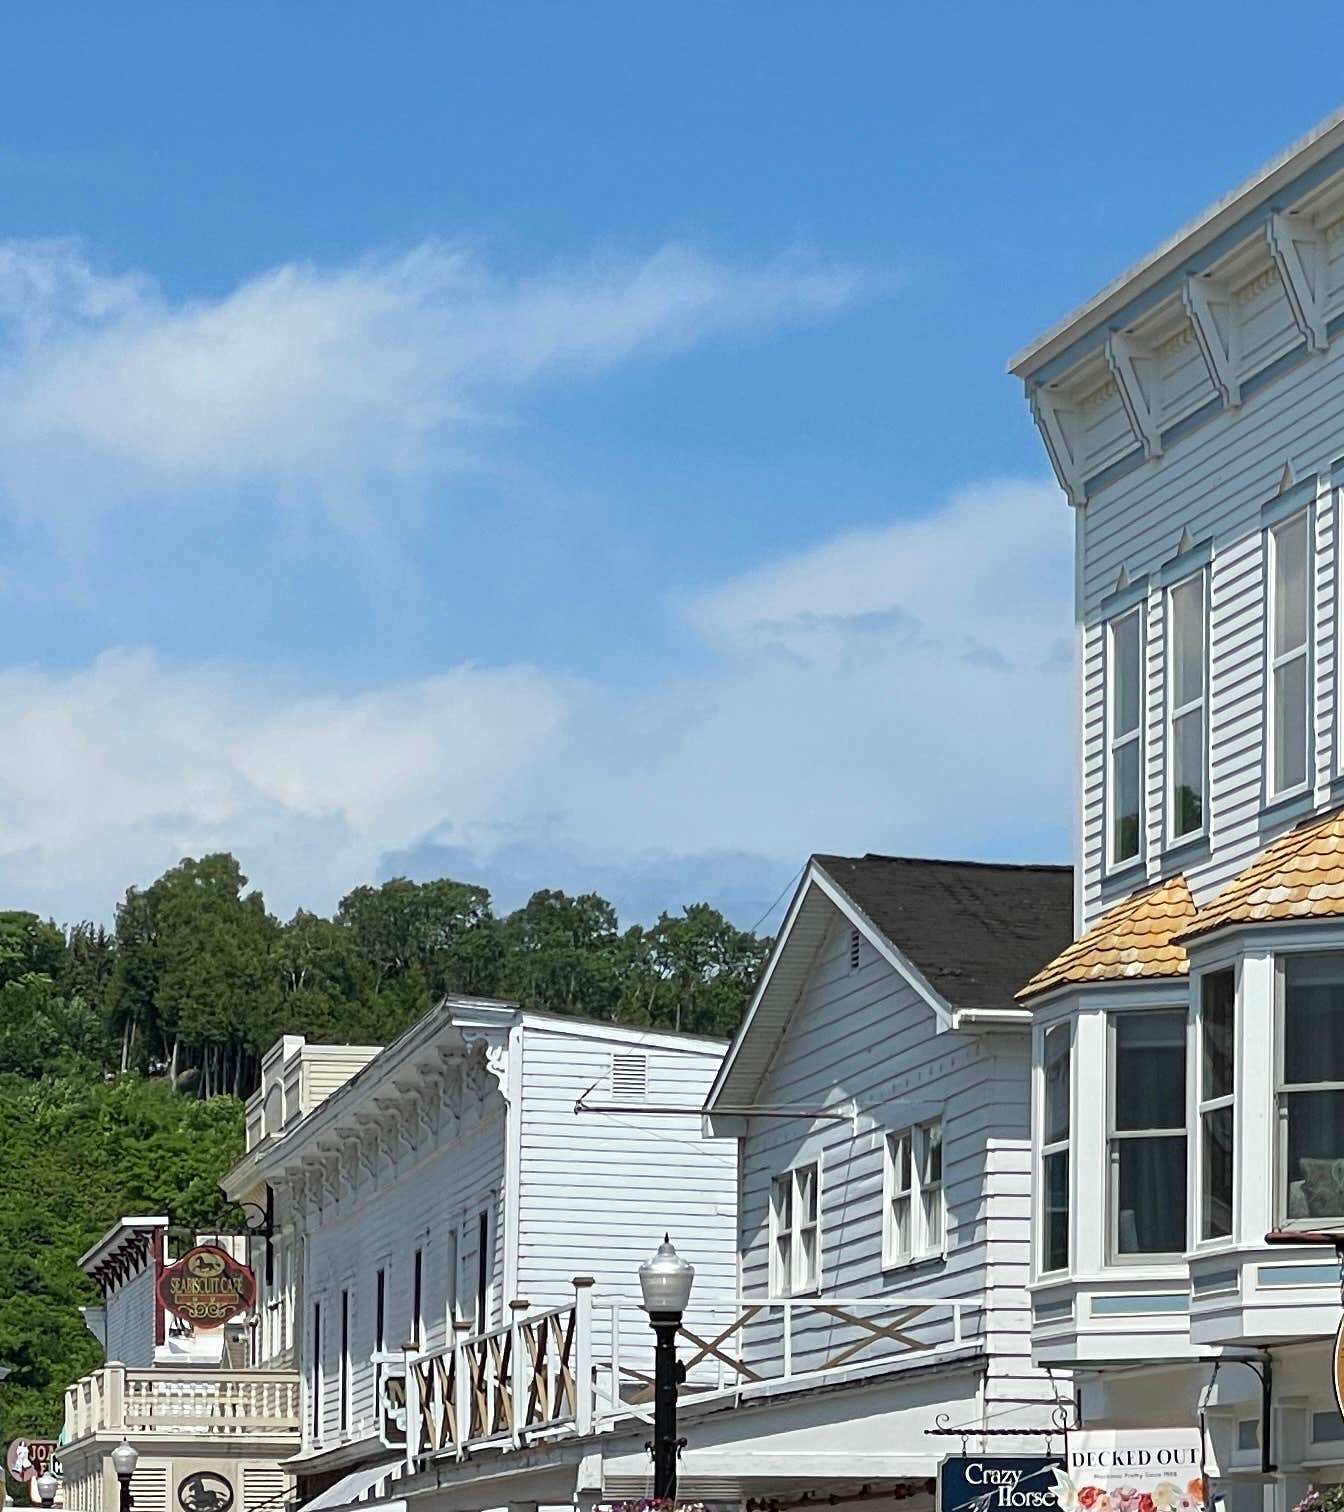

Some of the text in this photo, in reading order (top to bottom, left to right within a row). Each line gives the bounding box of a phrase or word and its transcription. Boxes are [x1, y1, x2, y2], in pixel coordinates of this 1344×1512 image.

[1072, 1448, 1200, 1467] DECKED OUT
[965, 1463, 1023, 1487] Crazy
[997, 1485, 1056, 1507] Horse
